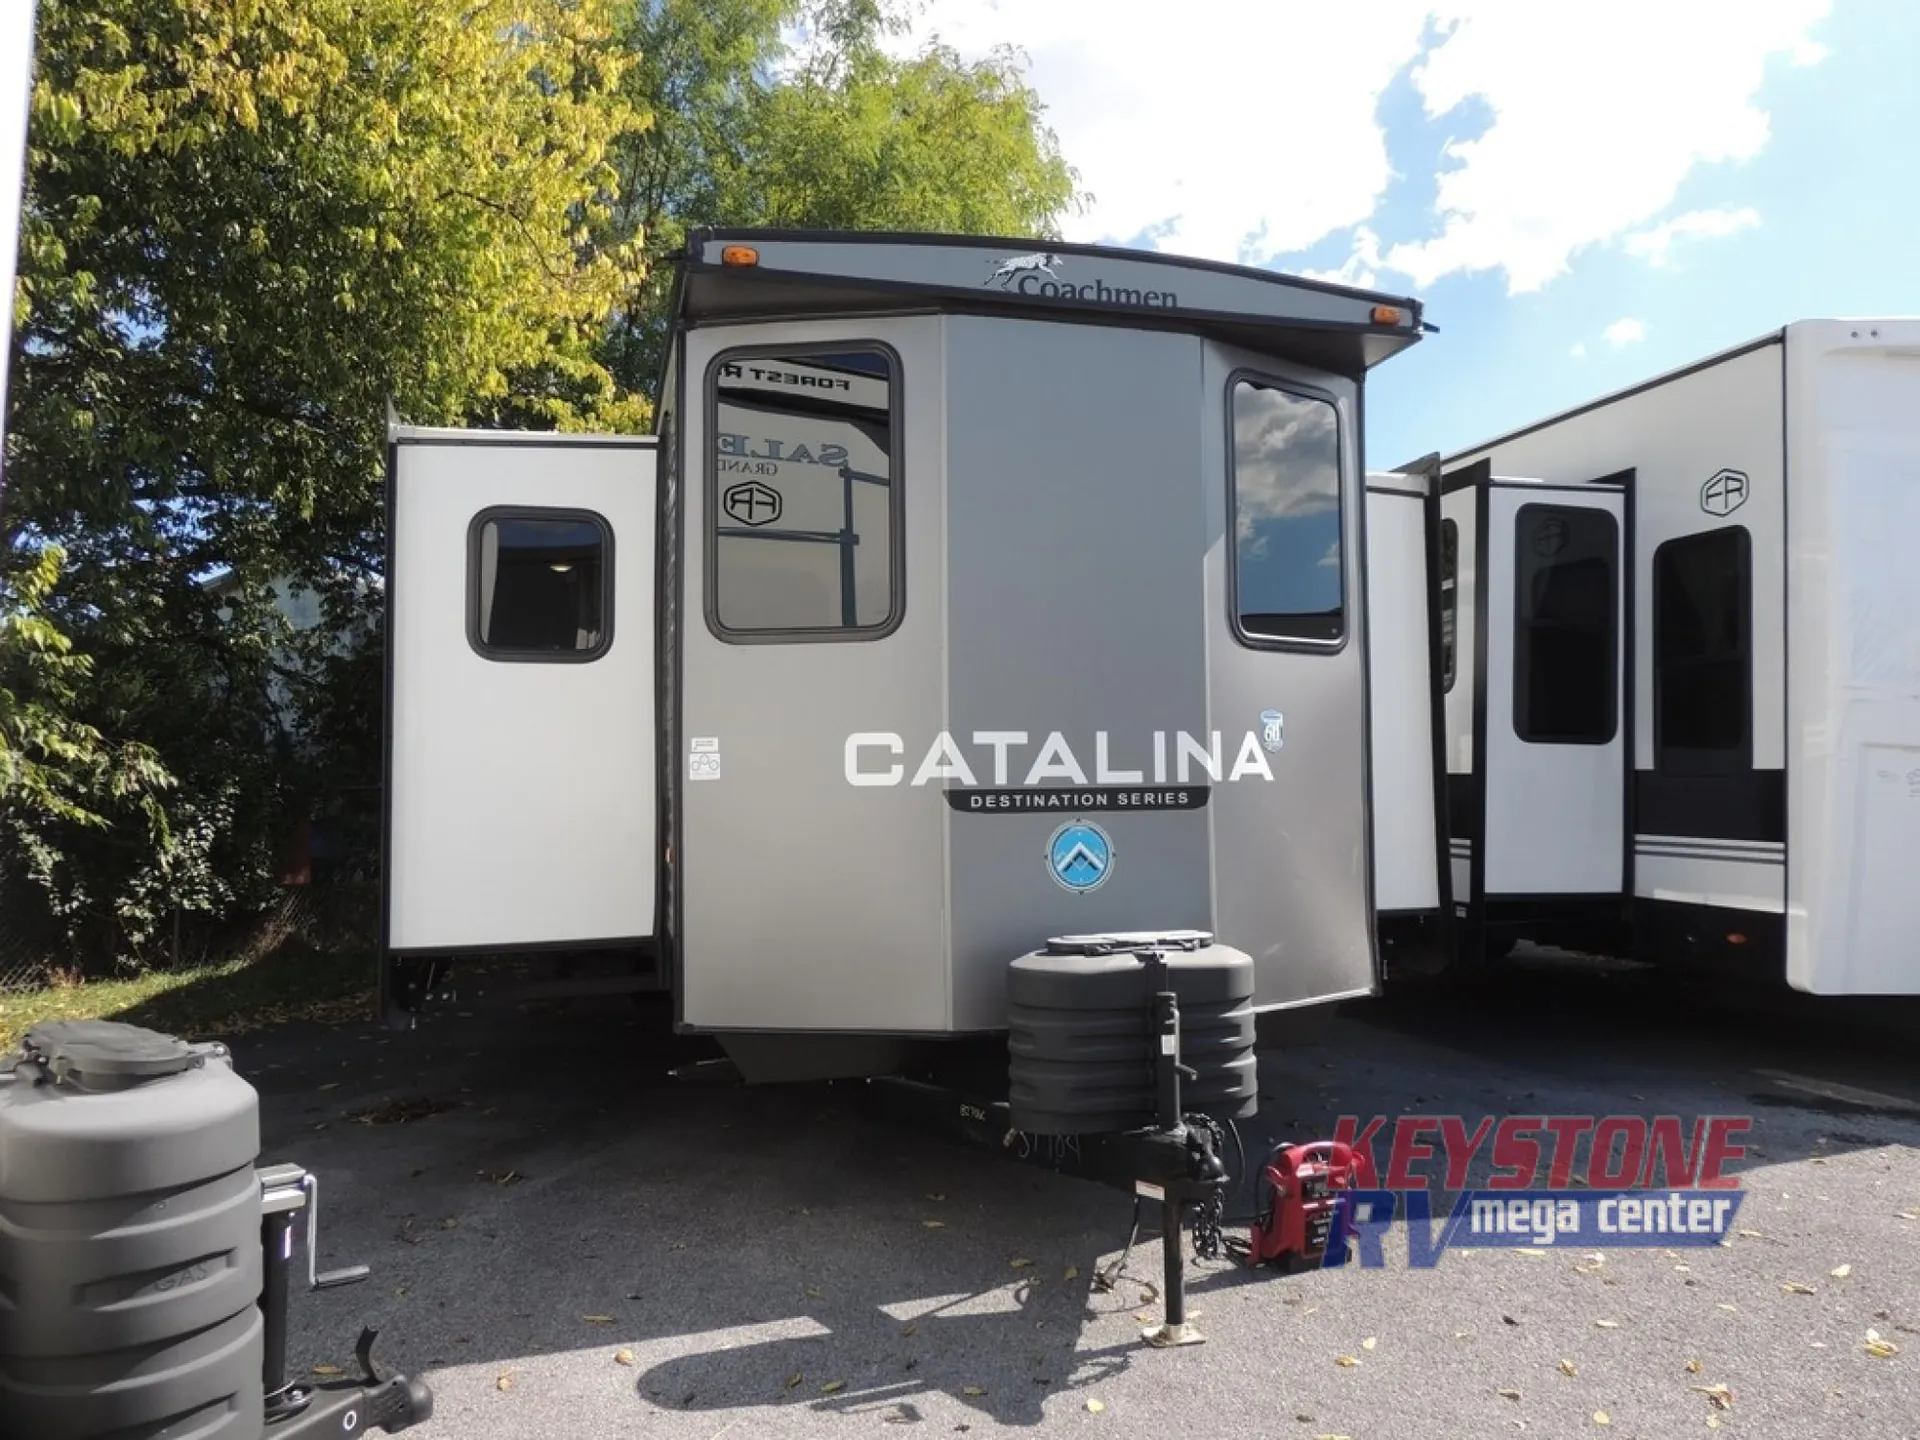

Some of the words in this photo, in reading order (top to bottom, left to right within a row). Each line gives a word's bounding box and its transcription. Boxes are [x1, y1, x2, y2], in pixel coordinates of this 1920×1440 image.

[1017, 275, 1179, 308] Coachmen
[844, 730, 1275, 787] CATALINA
[970, 793, 1109, 808] DESTINATION
[1117, 791, 1190, 805] SERIES
